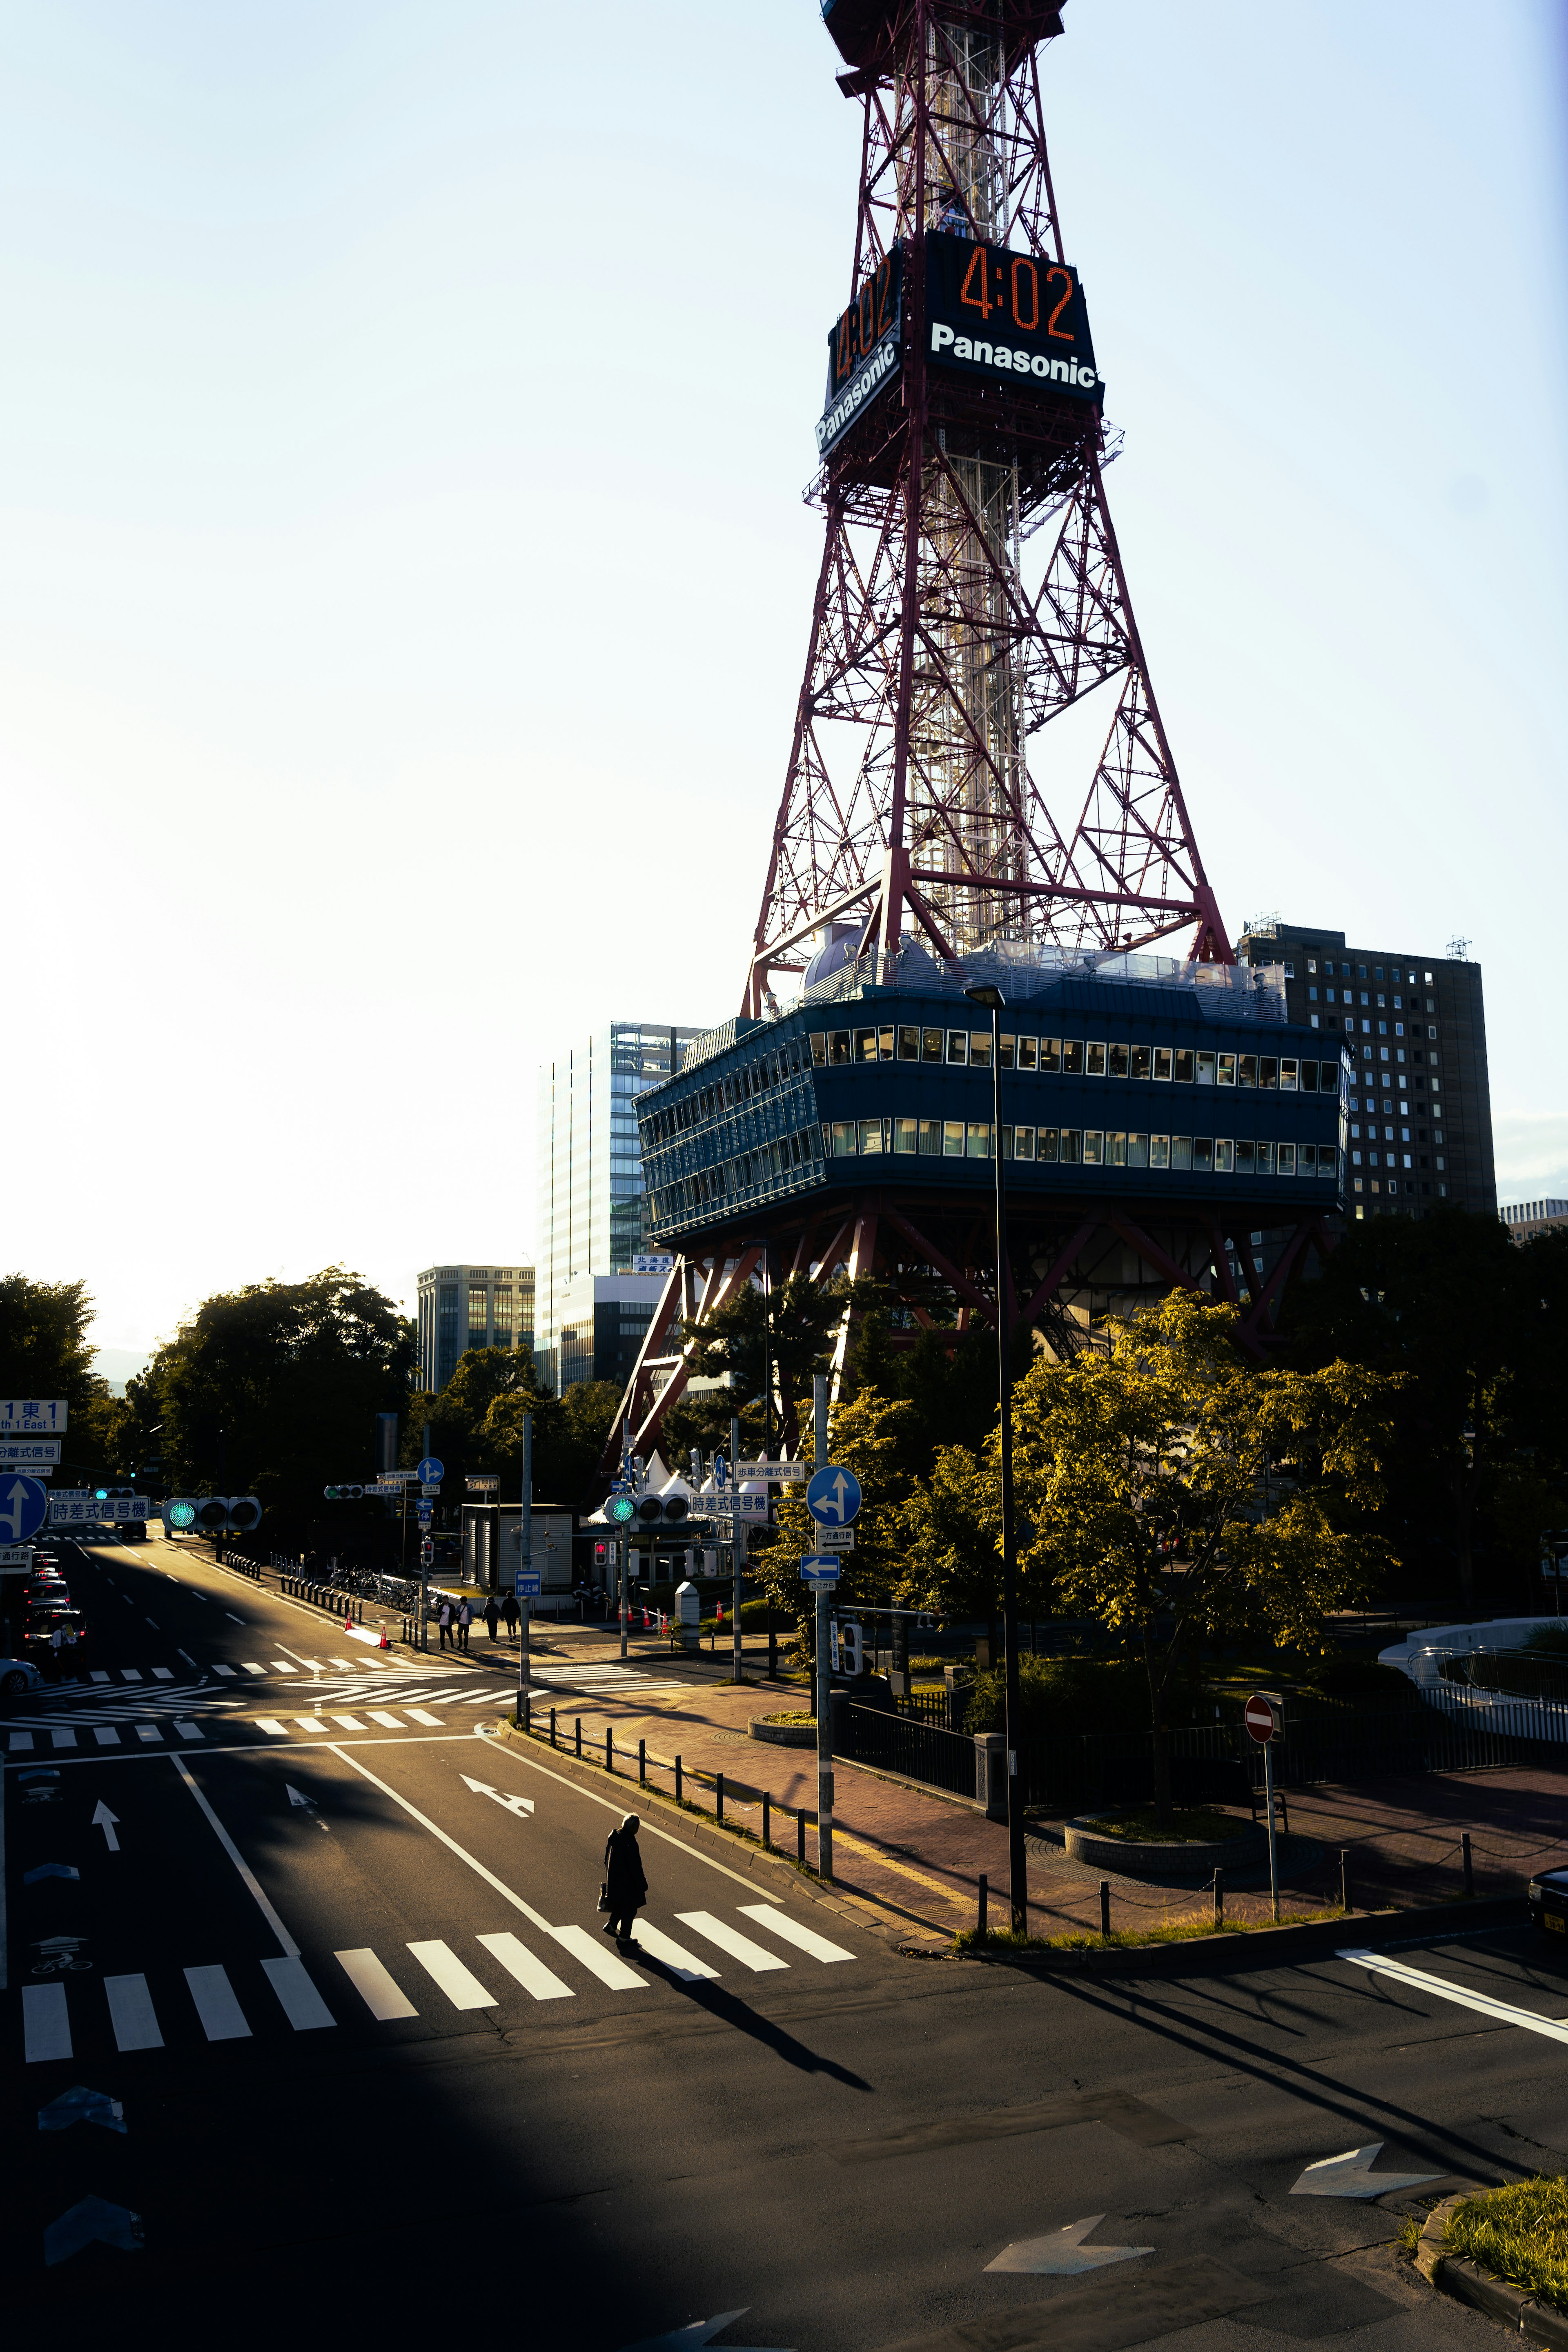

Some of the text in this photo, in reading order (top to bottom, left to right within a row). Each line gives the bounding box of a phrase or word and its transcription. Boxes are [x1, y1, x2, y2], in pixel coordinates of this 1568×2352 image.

[961, 246, 1074, 341] 4:02
[837, 255, 892, 380] 4:02
[931, 322, 1095, 388] Panasonic
[817, 342, 894, 450] Panasonic
[0, 1420, 56, 1429] th 1 East 1
[737, 1467, 801, 1477] 歩車分離式信号
[366, 1485, 401, 1493] 時差式信号機
[694, 1496, 766, 1511] 時差式信号機
[53, 1501, 146, 1520] 時差式信号機
[421, 1512, 429, 1520] 停
[820, 1531, 852, 1540] 一方通行路
[0, 1551, 29, 1560] 通行路
[518, 1584, 539, 1592] 停止線
